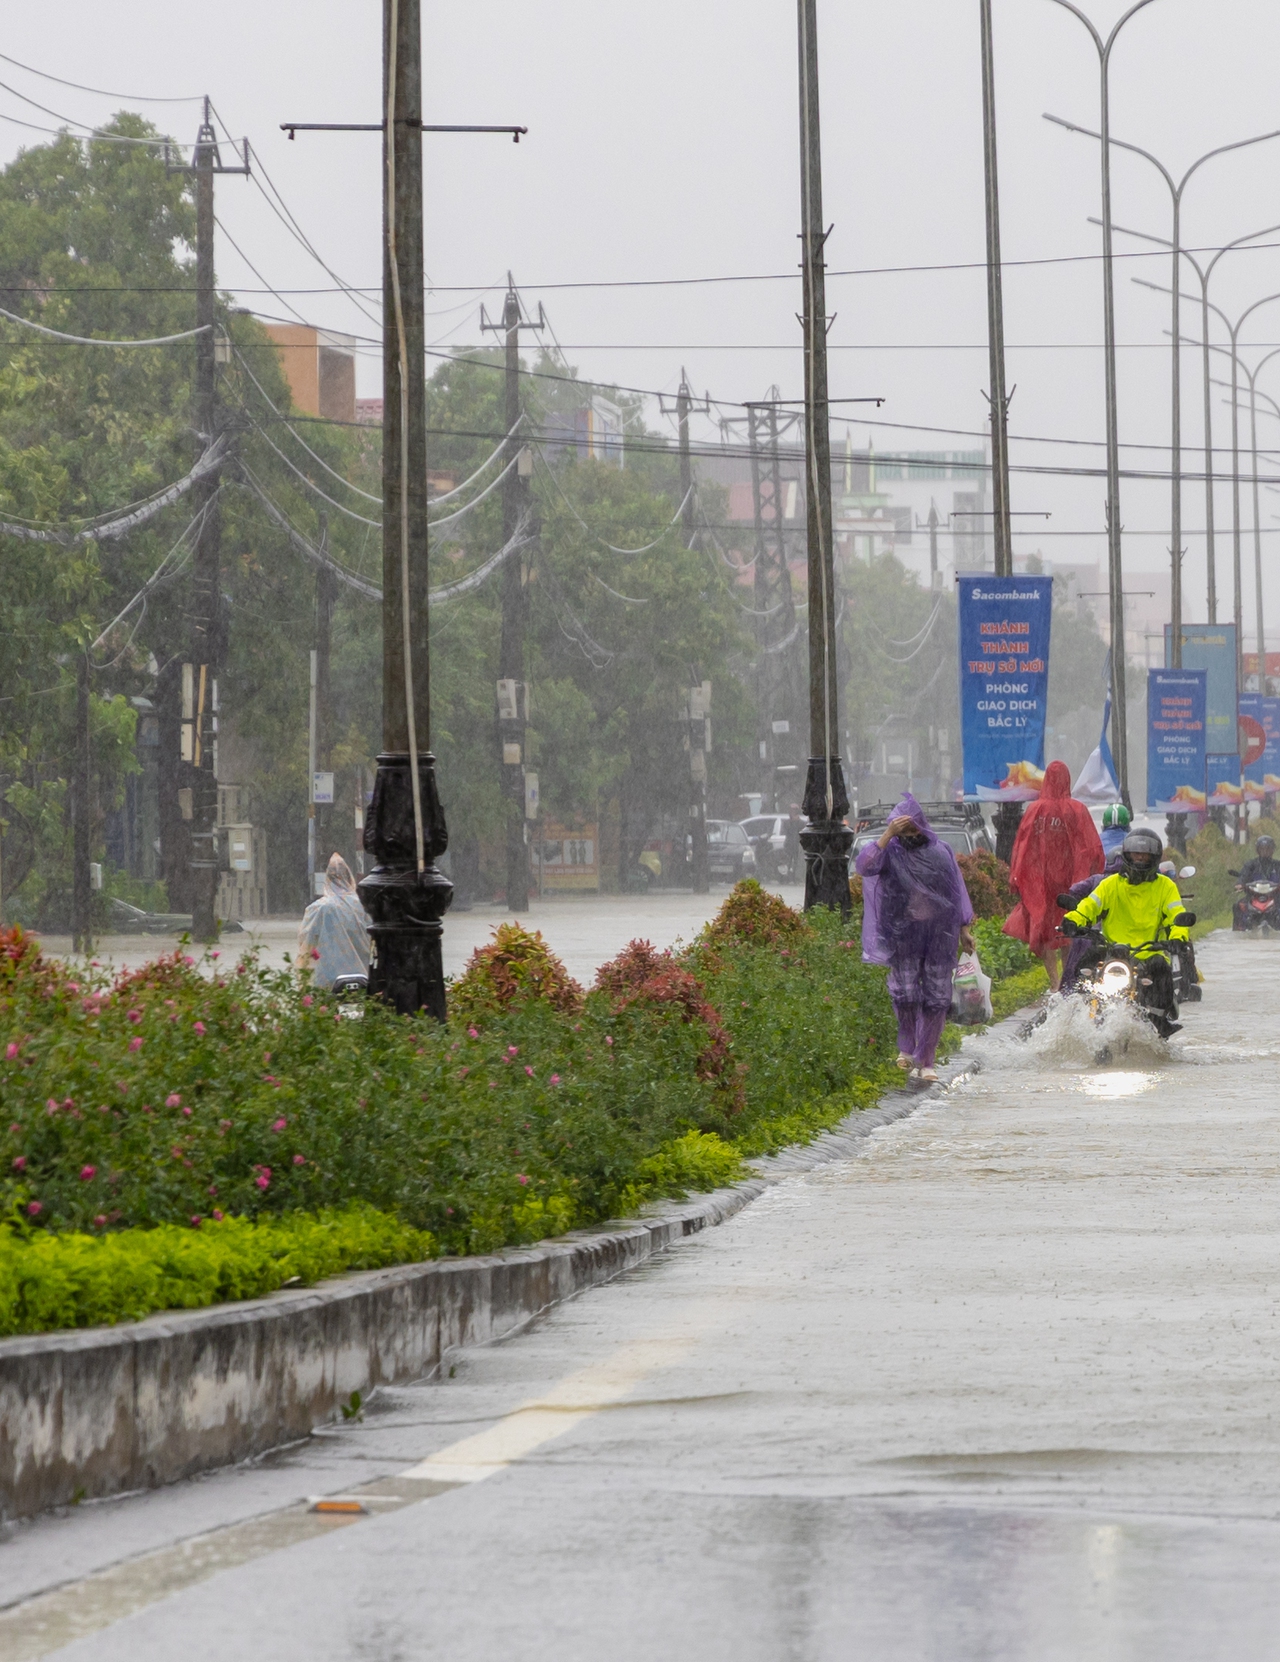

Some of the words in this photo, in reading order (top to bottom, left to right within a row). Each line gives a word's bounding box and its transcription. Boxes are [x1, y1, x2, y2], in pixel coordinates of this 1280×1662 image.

[971, 588, 1040, 600] Sacombank
[980, 619, 1030, 635] KHÁNH
[981, 638, 1030, 654] THÀNH
[968, 661, 995, 676] TRỤ
[998, 656, 1017, 673] SỞ
[1020, 657, 1044, 673] MỚI
[986, 681, 1029, 694] PHÒNG
[977, 700, 1006, 711] GIAO
[1009, 700, 1037, 713] DỊCH
[987, 713, 1012, 727] BẮC
[1015, 714, 1028, 727] LÝ
[1157, 746, 1177, 754] GIAO
